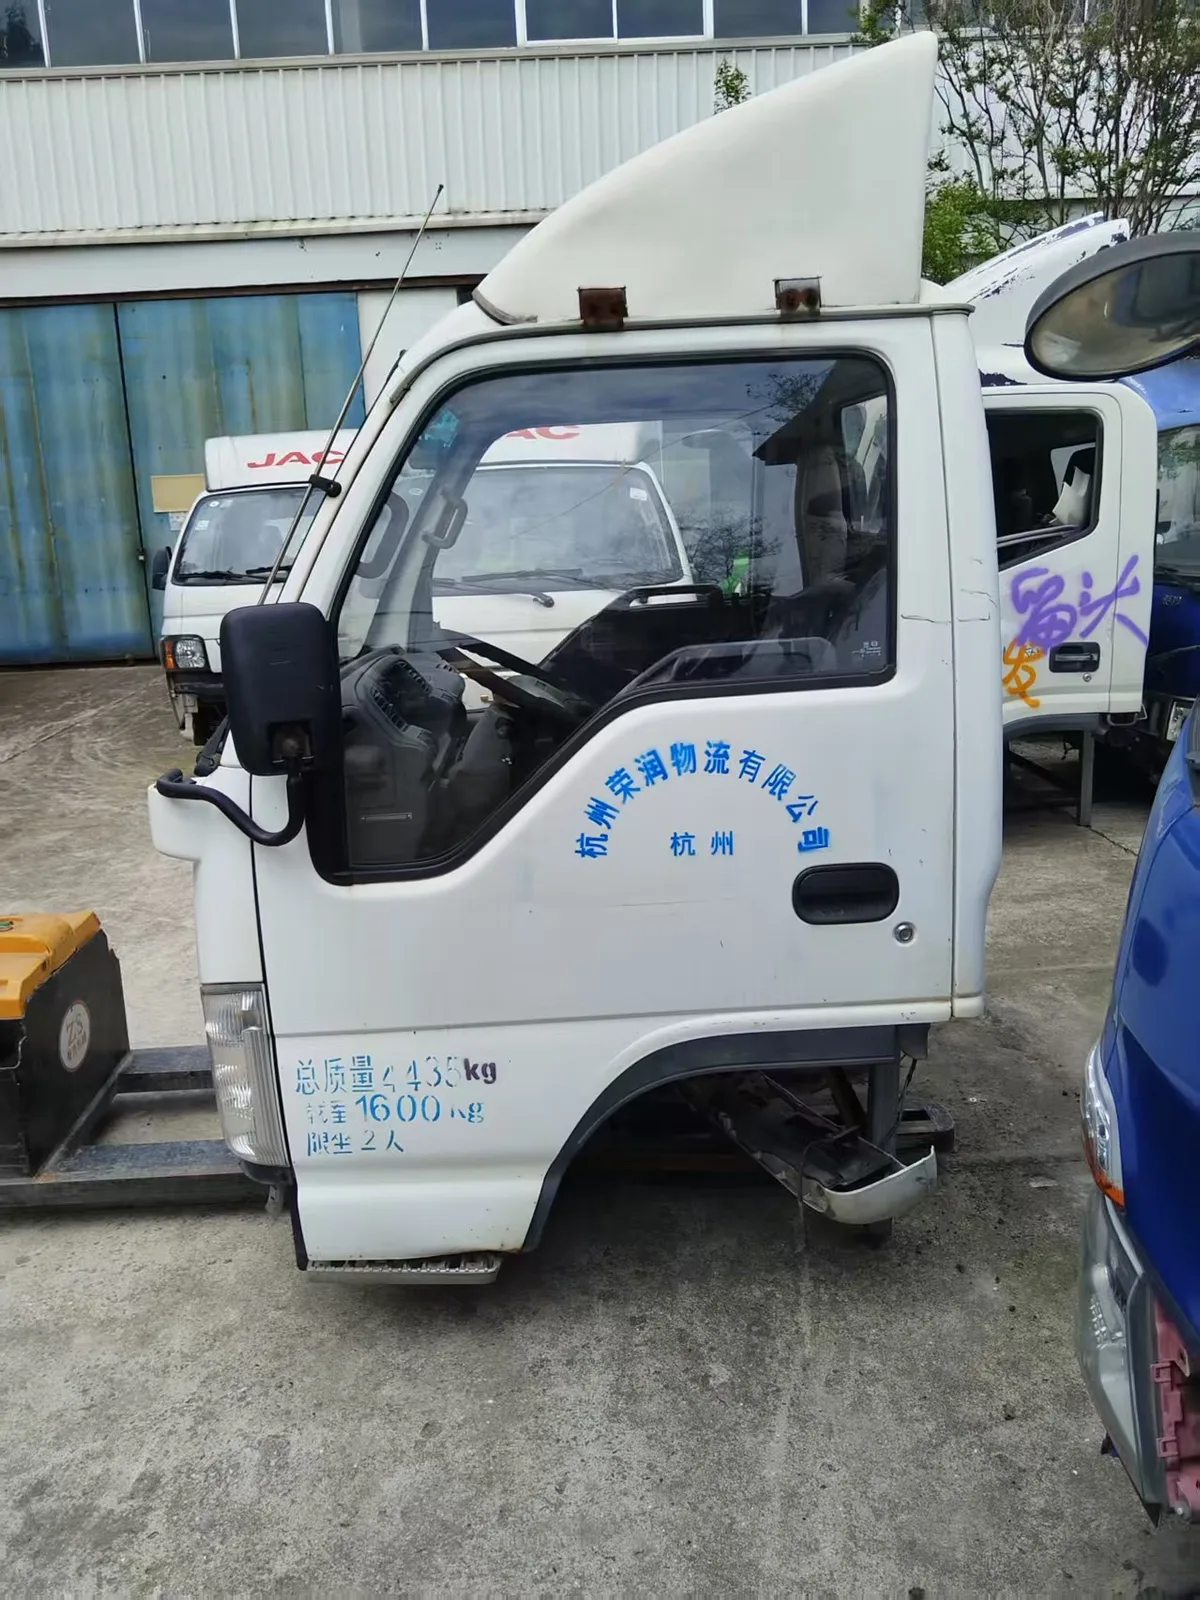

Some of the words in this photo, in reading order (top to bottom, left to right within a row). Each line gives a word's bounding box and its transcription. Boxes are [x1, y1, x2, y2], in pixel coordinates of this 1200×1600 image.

[247, 451, 345, 468] JAC
[574, 739, 830, 859] 杭州荣润物流有限公司
[670, 831, 735, 857] 杭州
